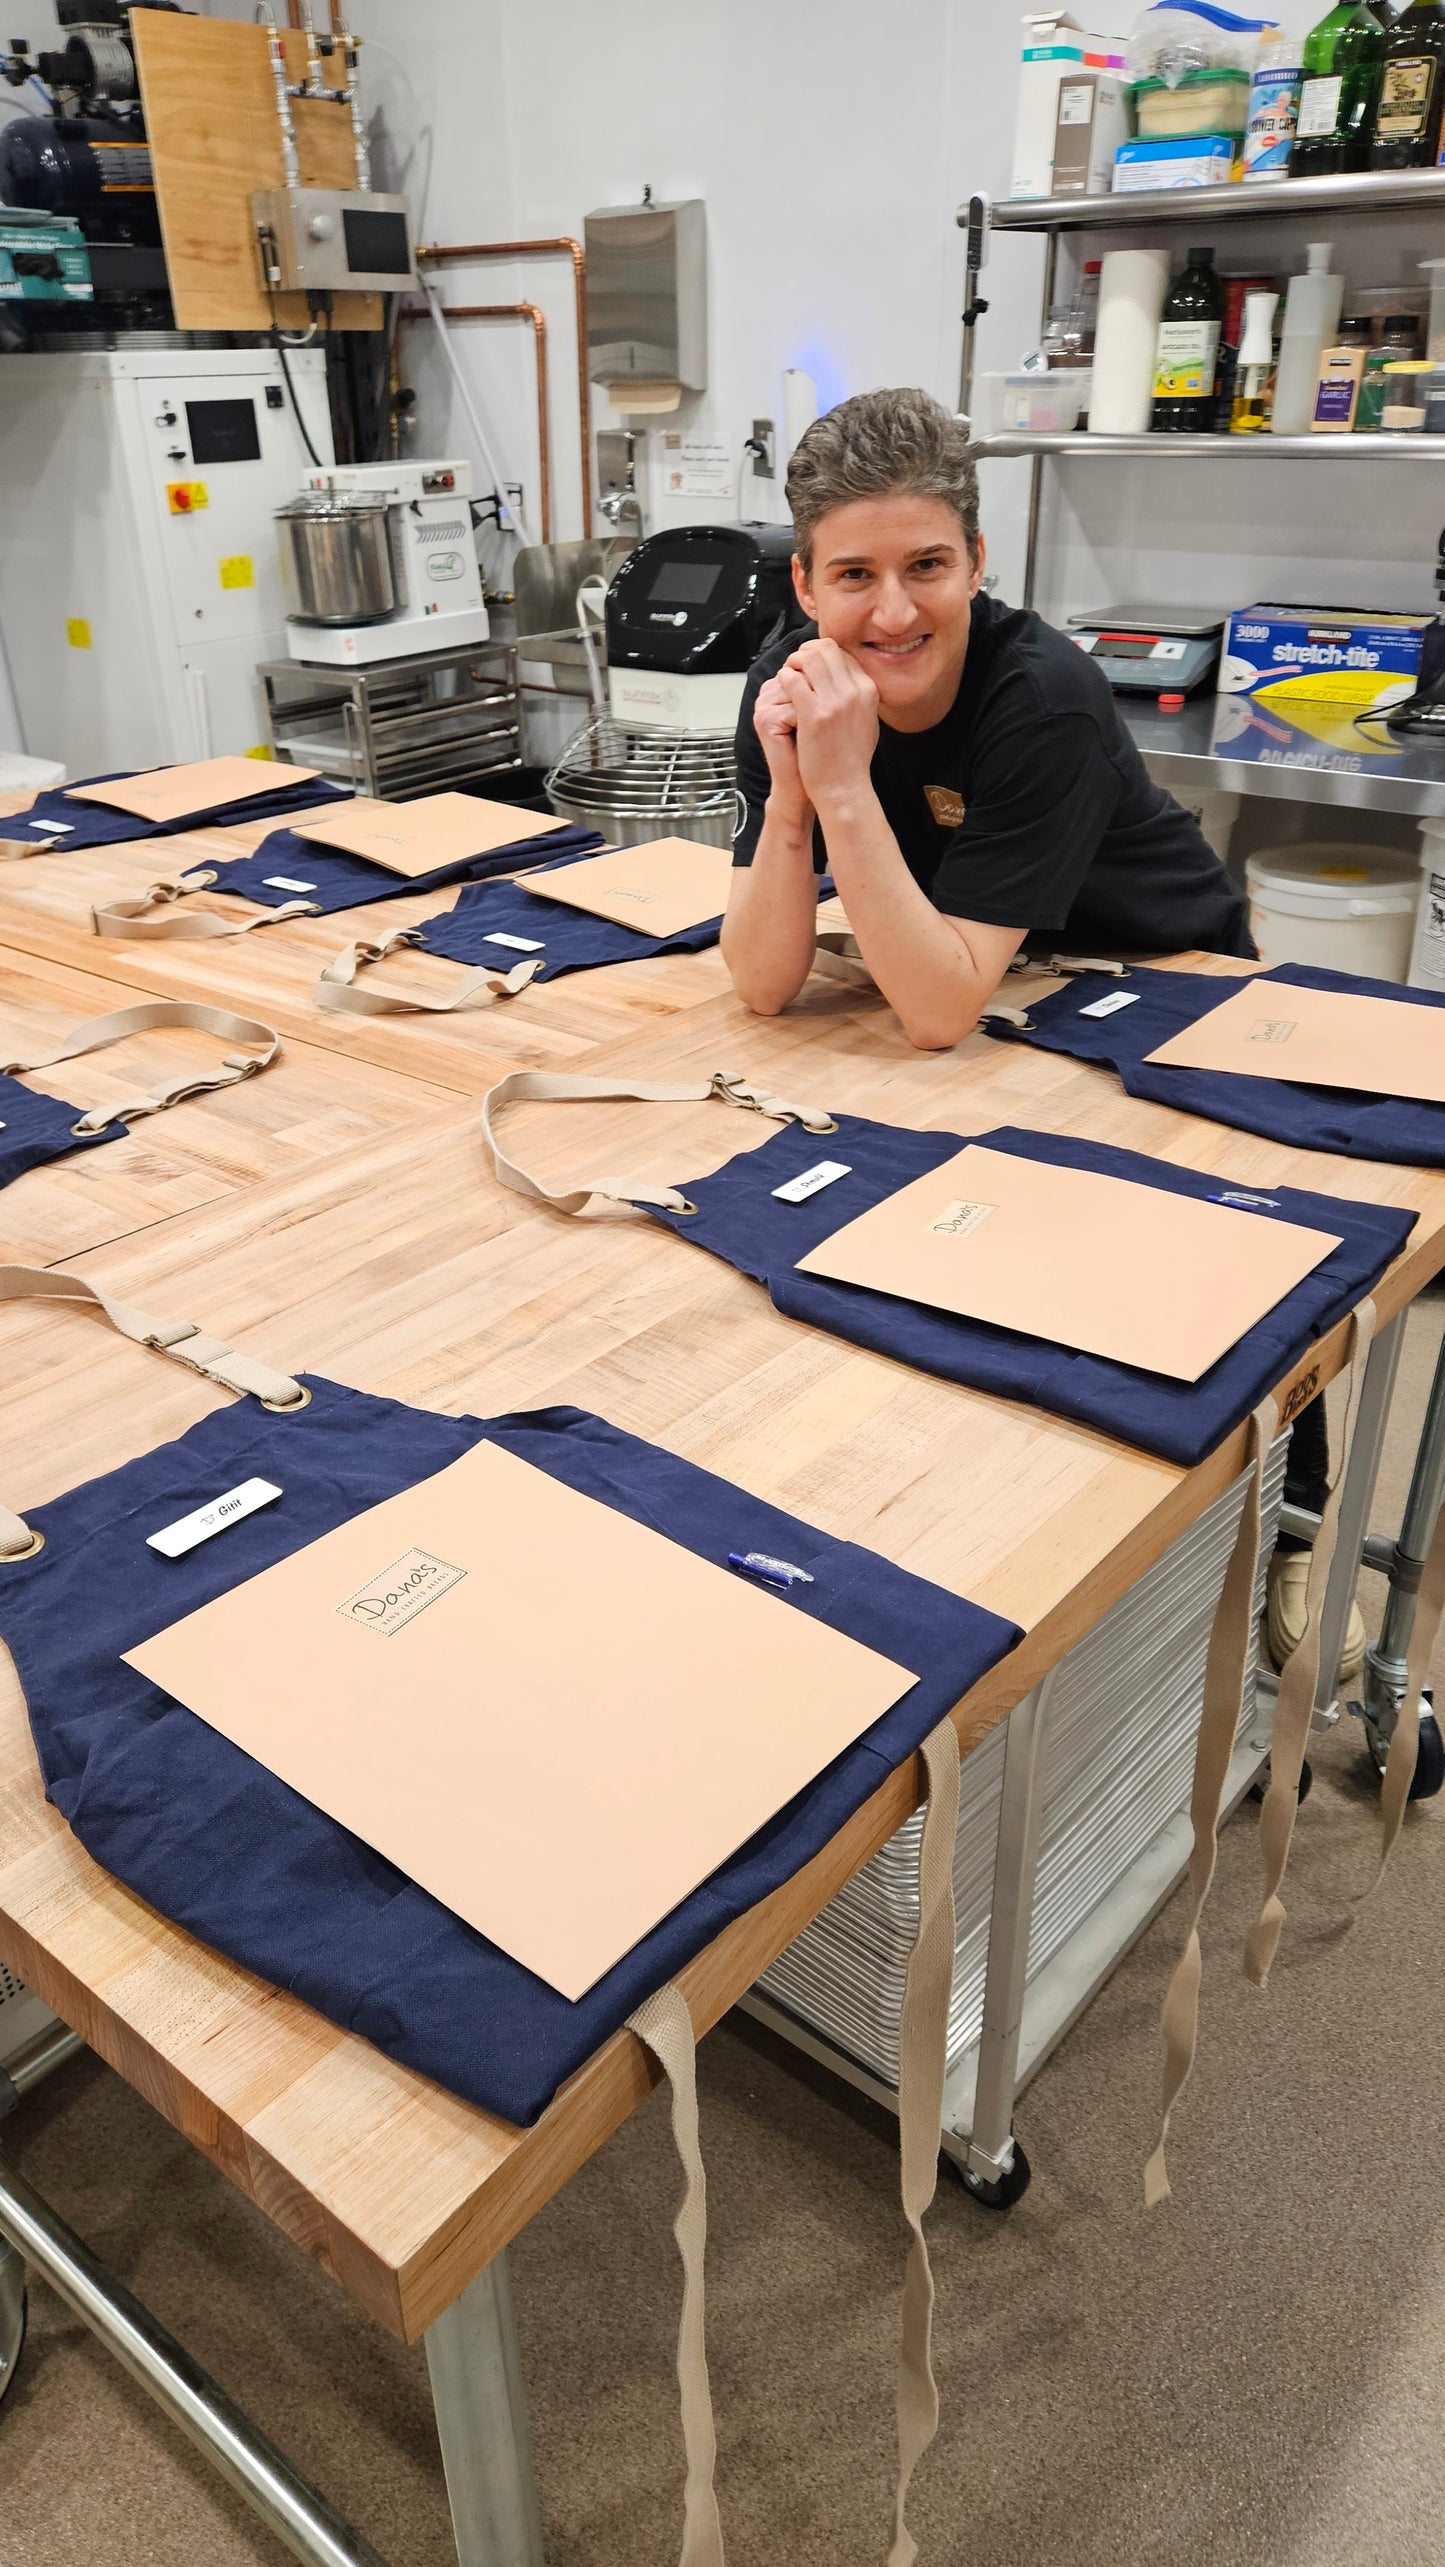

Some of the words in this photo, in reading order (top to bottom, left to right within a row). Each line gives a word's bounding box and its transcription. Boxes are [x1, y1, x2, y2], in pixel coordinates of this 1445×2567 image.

[1234, 624, 1270, 639] 3000
[1272, 643, 1380, 668] stretch-tite
[1273, 686, 1311, 698] PLASTIC
[1312, 689, 1340, 700] FOOD
[933, 1204, 978, 1233] Dana's
[218, 1498, 243, 1516] Gitit
[351, 1563, 438, 1621] Dana's
[382, 1611, 401, 1626] HAND
[400, 1590, 427, 1611] CRAFTED
[427, 1572, 450, 1590] BREADS
